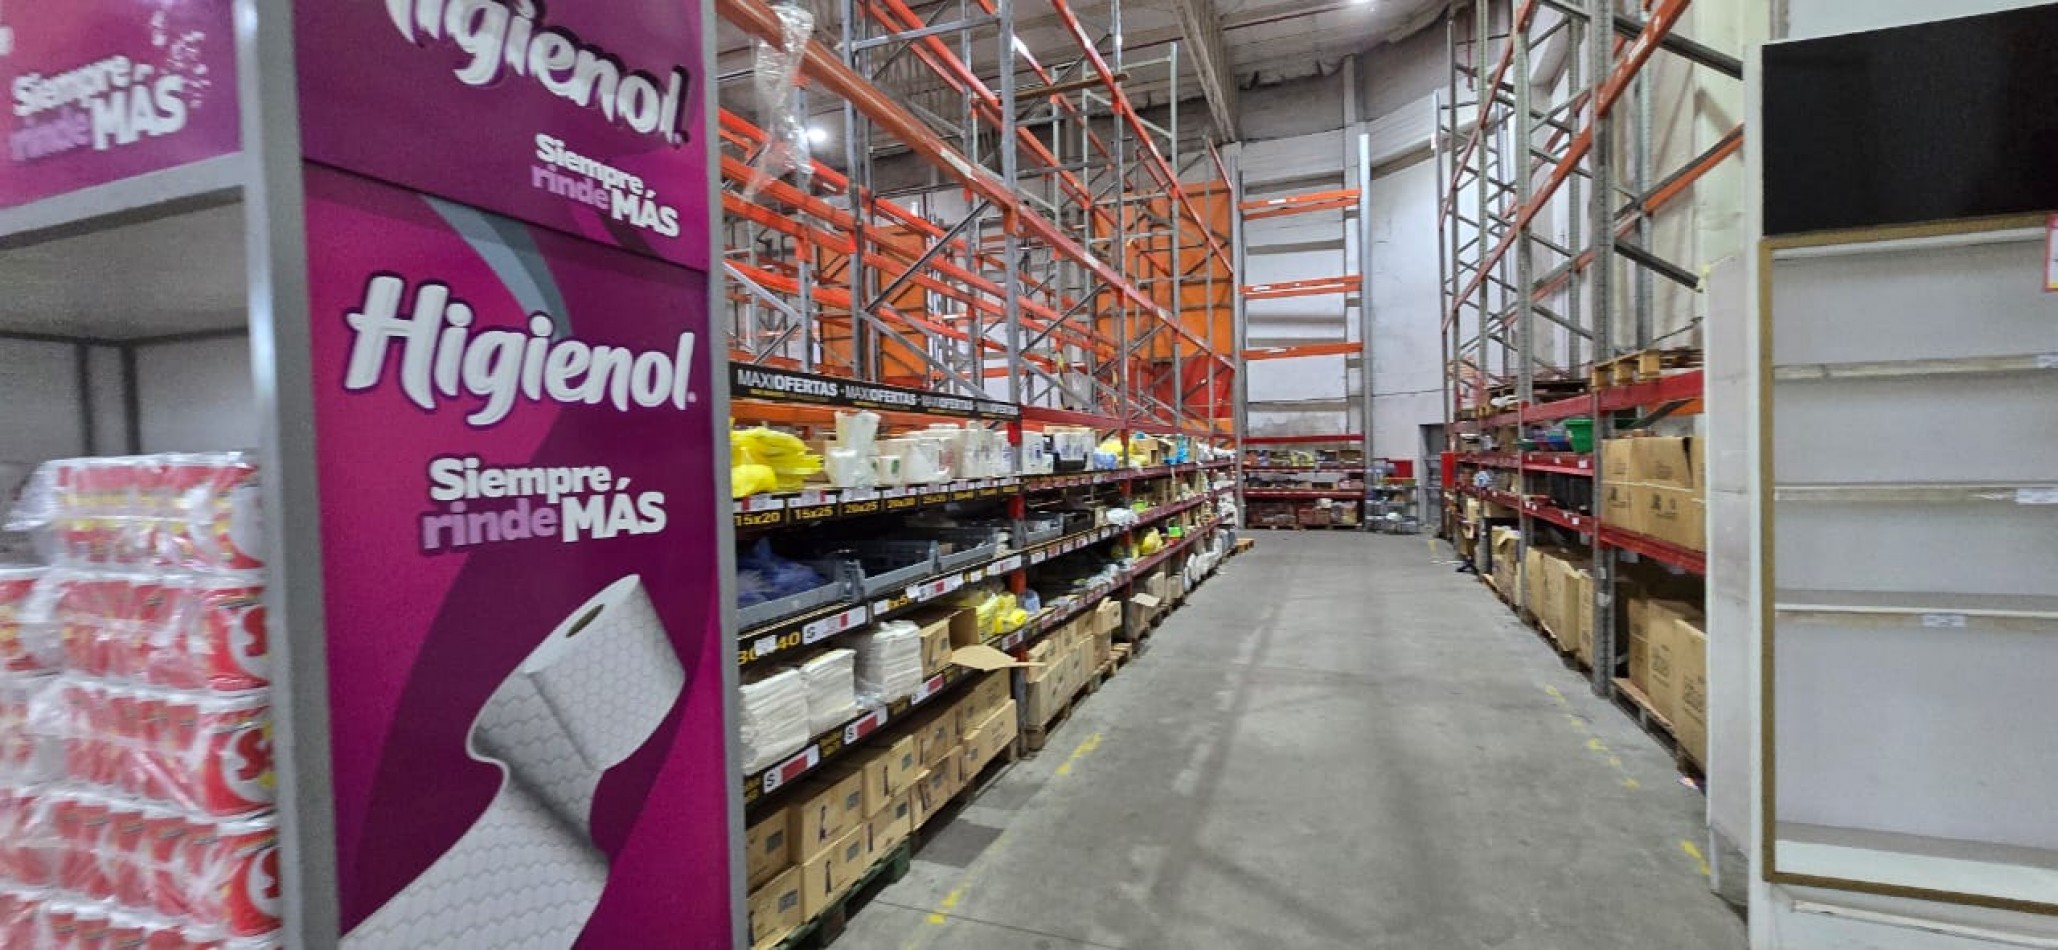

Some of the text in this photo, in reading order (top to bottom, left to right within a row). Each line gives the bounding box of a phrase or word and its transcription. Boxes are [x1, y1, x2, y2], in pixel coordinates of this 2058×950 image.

[12, 55, 131, 117] Siempre
[92, 63, 187, 150] MÁS
[535, 133, 644, 196] Siempre
[531, 165, 680, 237] rinde MÁS
[344, 275, 697, 426] Higienol
[429, 458, 612, 504] Siempre
[423, 477, 667, 549] rinde MÁS
[735, 512, 780, 526] 15x20
[794, 506, 833, 519] 15x25
[738, 631, 801, 665] 3040
